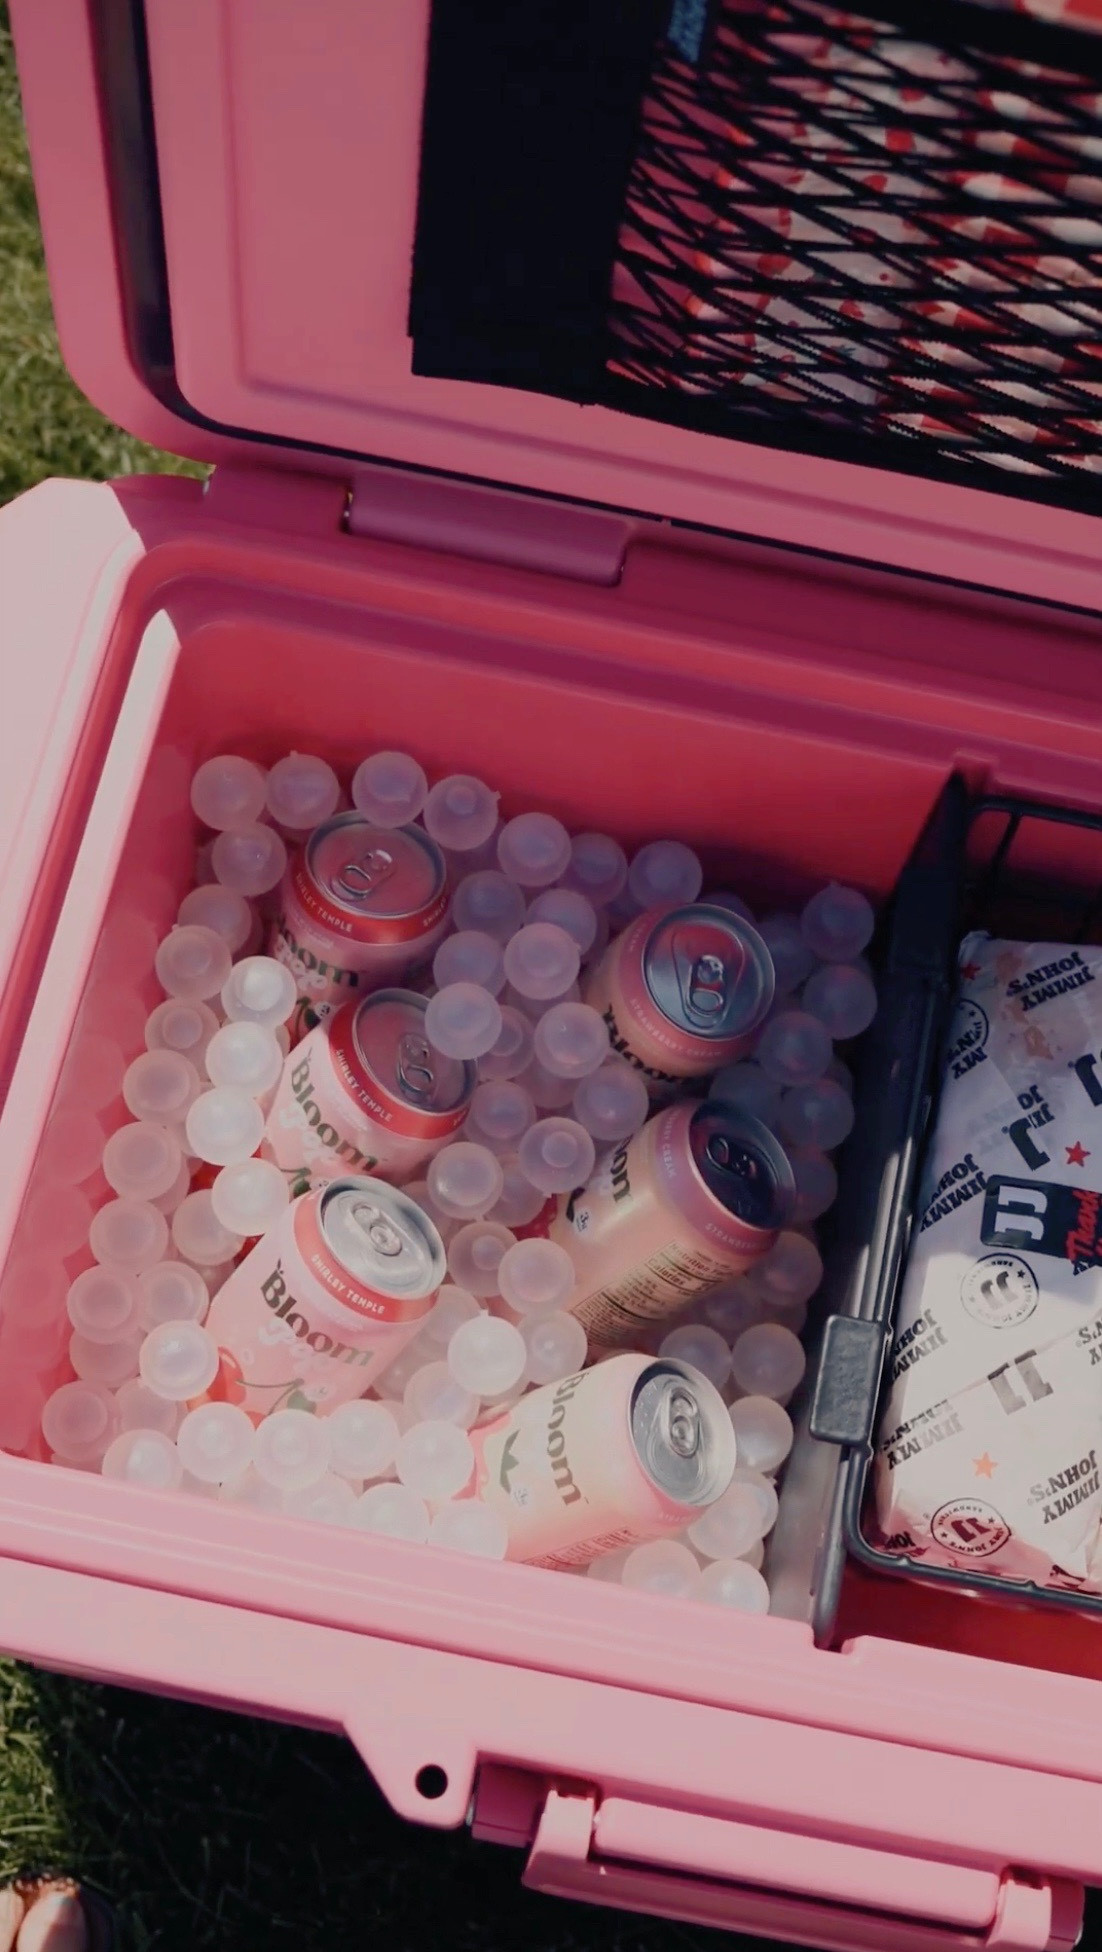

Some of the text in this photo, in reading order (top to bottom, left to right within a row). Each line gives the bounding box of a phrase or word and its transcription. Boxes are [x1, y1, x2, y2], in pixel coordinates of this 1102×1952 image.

[317, 907, 353, 932] TEMPLE
[1008, 951, 1085, 996] JOHN'S
[1020, 966, 1096, 1012] JIMMY
[335, 1049, 394, 1122] SHIRLEY TEMPLE
[291, 1055, 378, 1172] Bloom
[662, 1144, 678, 1178] CREAM
[920, 1170, 987, 1233] JIMMY
[994, 1185, 1048, 1240] JJ
[310, 1254, 387, 1315] SHIRLEY TEMPLE
[260, 1267, 376, 1367] Bloom
[894, 1326, 949, 1381] JIMM
[547, 1372, 590, 1505] Bloom
[887, 1412, 964, 1471] JIMMY
[1030, 1449, 1098, 1502] JOHN'S
[1042, 1470, 1100, 1524] JIMMY
